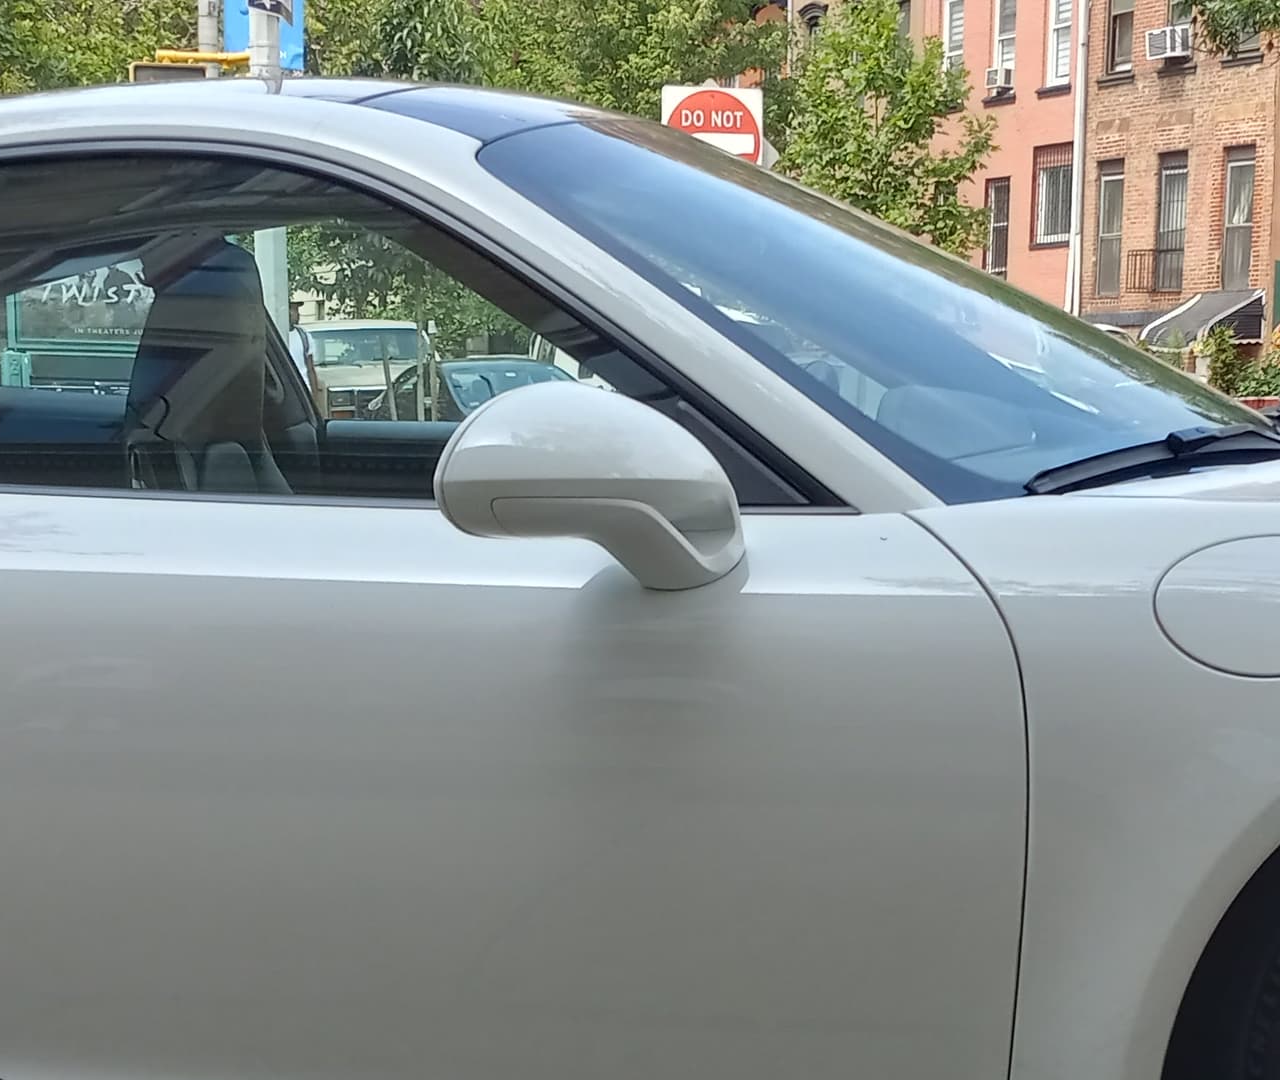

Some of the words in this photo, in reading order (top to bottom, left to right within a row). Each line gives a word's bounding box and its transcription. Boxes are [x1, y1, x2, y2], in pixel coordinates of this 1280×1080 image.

[681, 109, 705, 128] DO
[711, 110, 744, 129] NOT
[87, 327, 130, 335] THEATERS
